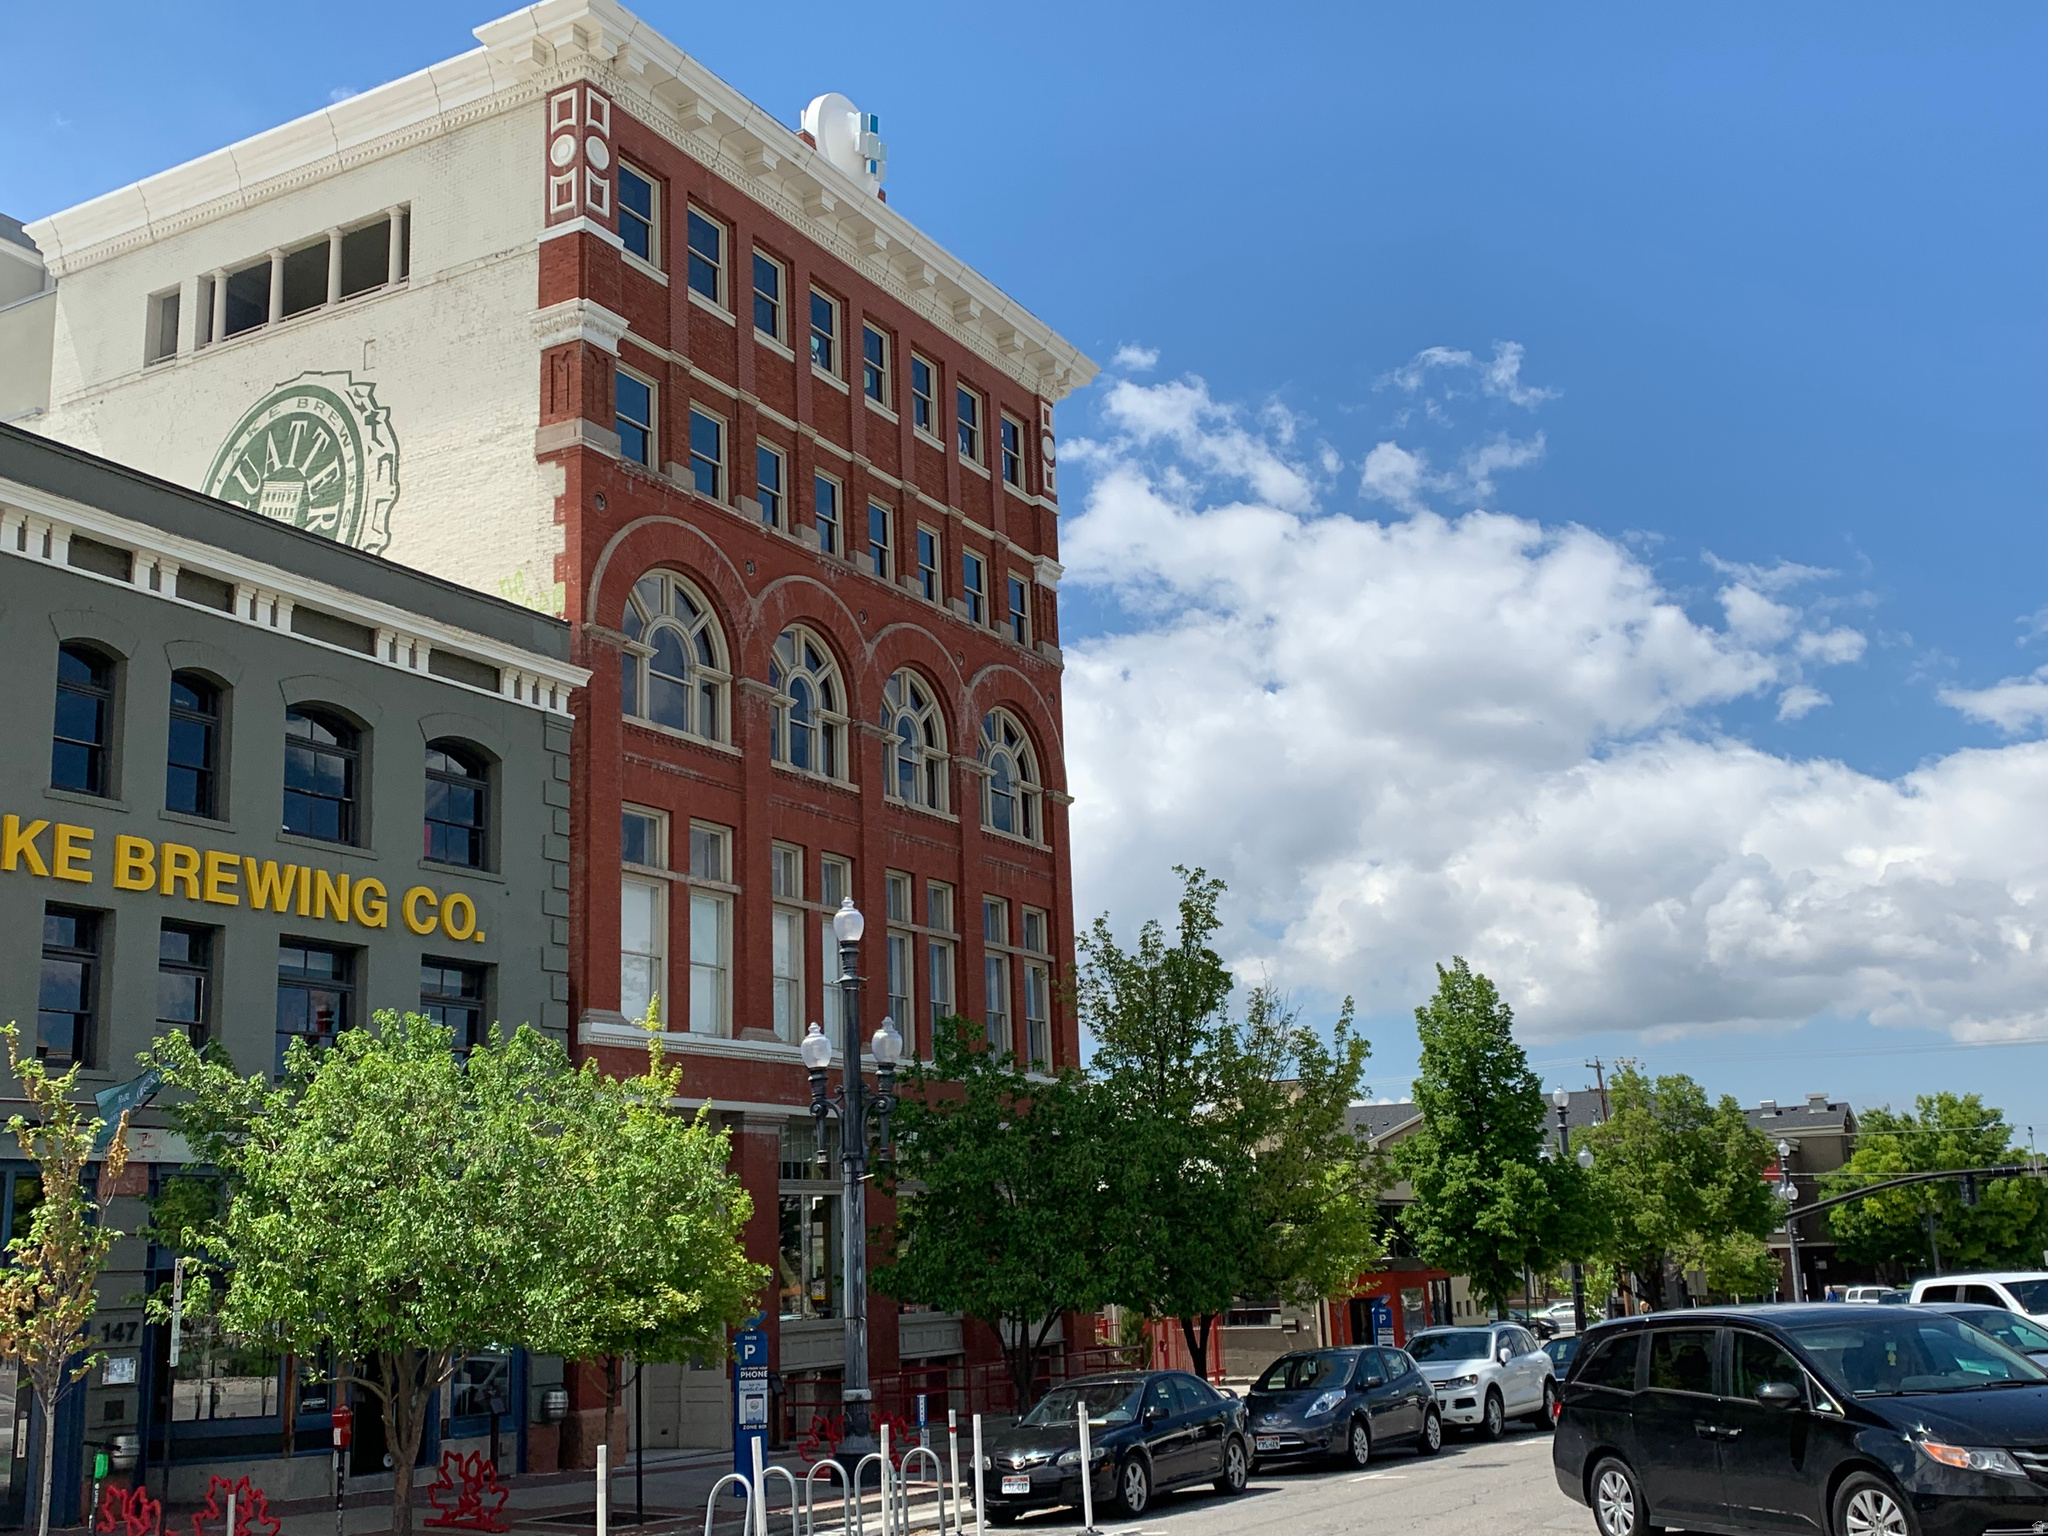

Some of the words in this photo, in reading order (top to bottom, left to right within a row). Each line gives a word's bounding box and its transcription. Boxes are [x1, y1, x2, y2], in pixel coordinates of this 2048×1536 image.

[216, 404, 280, 486] LAKE
[296, 397, 355, 530] BREWING
[226, 420, 341, 531] UATTER
[1, 813, 95, 883] KE
[113, 834, 388, 928] BREWING
[402, 885, 486, 943] CO.
[1379, 1314, 1387, 1324] P
[101, 1321, 139, 1342] 147
[744, 1344, 756, 1360] P
[740, 1370, 768, 1379] PHONE
